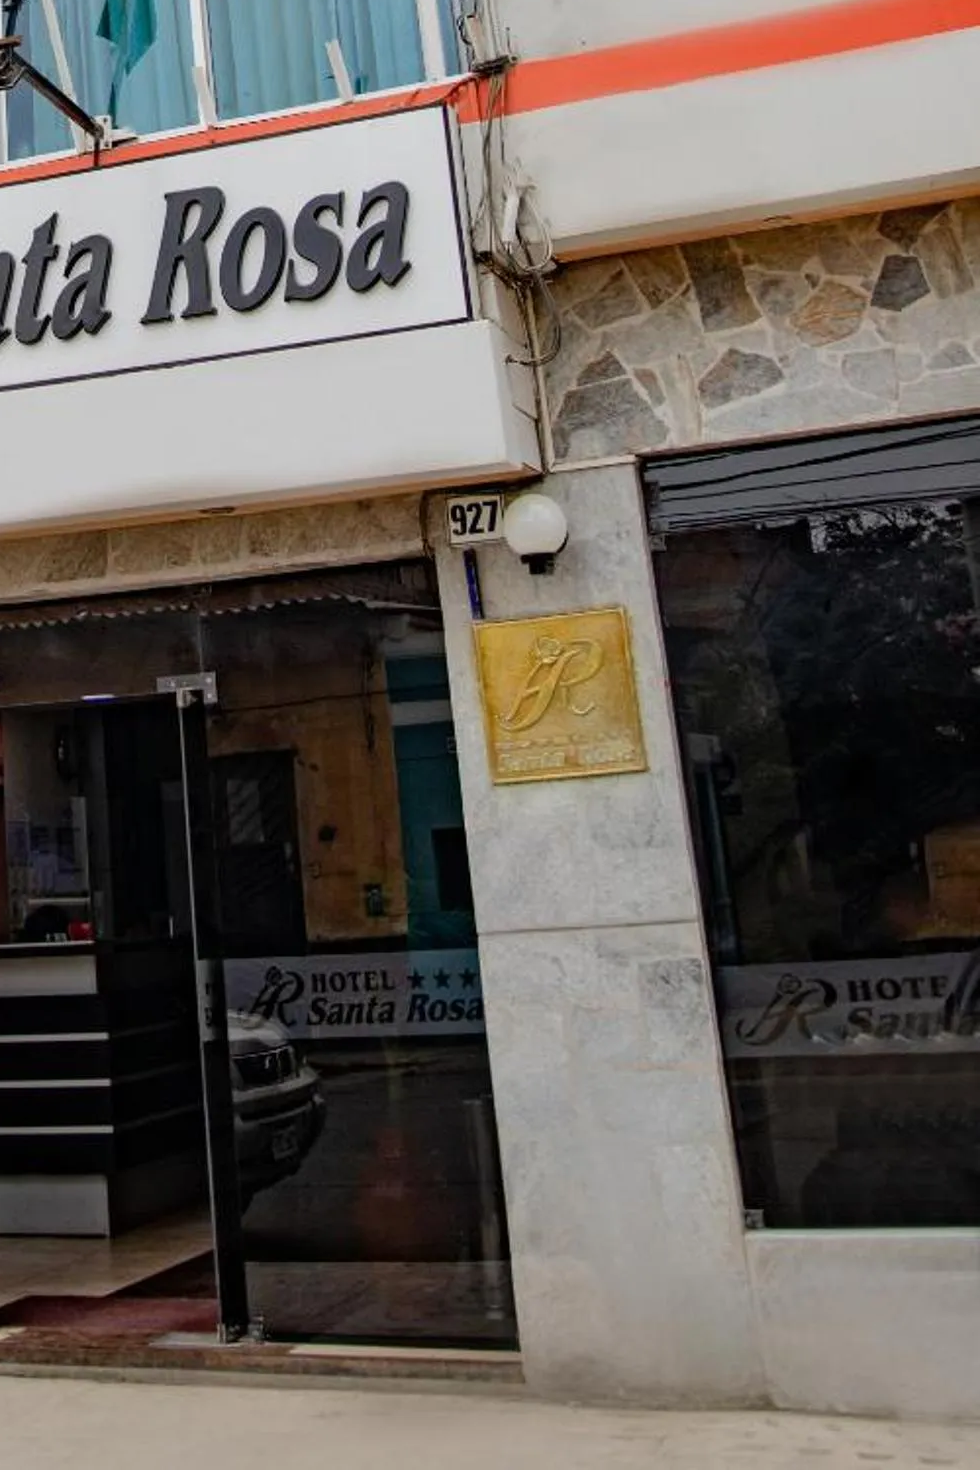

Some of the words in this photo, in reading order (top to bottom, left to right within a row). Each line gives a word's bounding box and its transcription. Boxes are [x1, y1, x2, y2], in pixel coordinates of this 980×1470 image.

[140, 180, 413, 327] Rosa
[450, 500, 499, 536] 927
[312, 970, 395, 993] HOTEL
[846, 975, 950, 1003] HOTE
[306, 996, 396, 1026] Santa
[405, 993, 485, 1023] Rosa
